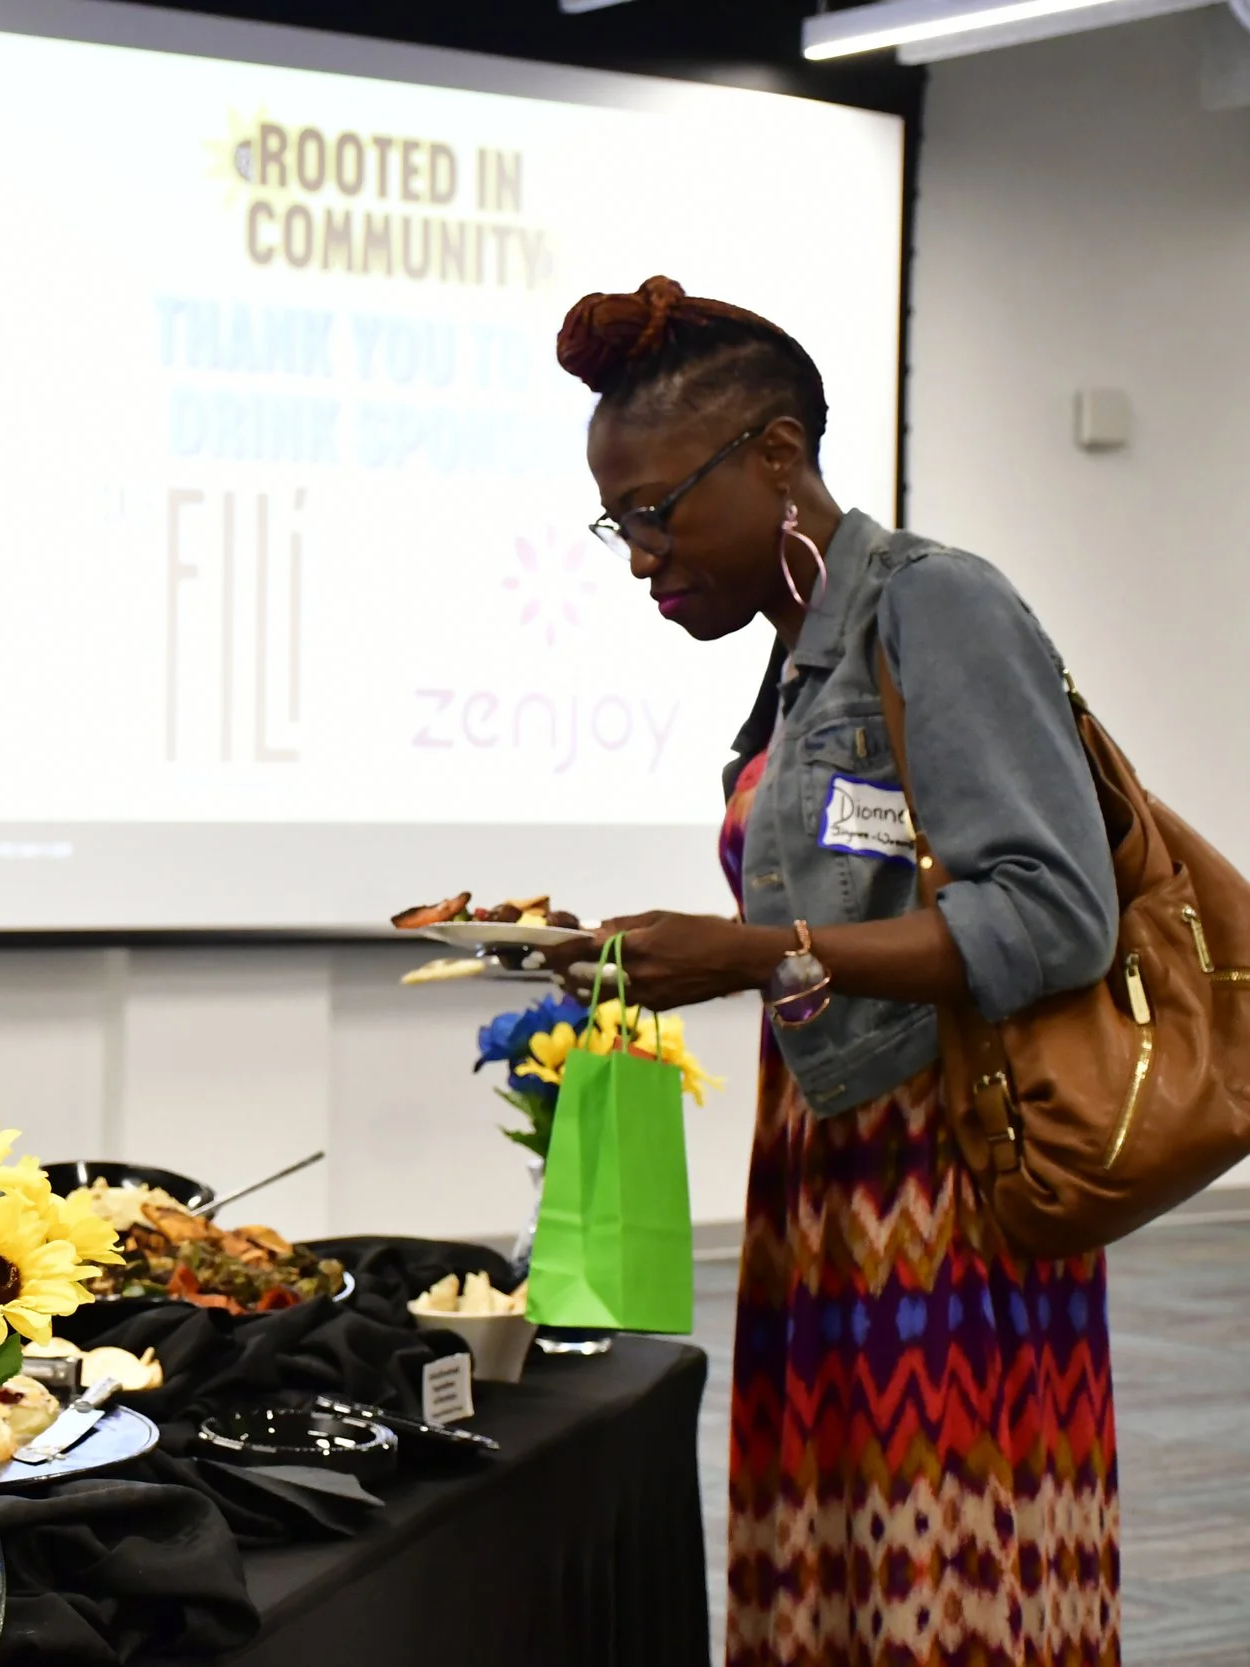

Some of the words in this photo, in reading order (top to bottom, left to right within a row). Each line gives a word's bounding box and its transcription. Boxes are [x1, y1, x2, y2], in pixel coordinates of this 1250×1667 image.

[258, 120, 458, 205] ROOTED
[477, 146, 523, 213] IN
[246, 199, 546, 290] COMMUNITY
[154, 295, 334, 379] THANK
[350, 311, 456, 388] YOU
[170, 387, 340, 465] DRINK
[411, 689, 680, 774] zenjoy
